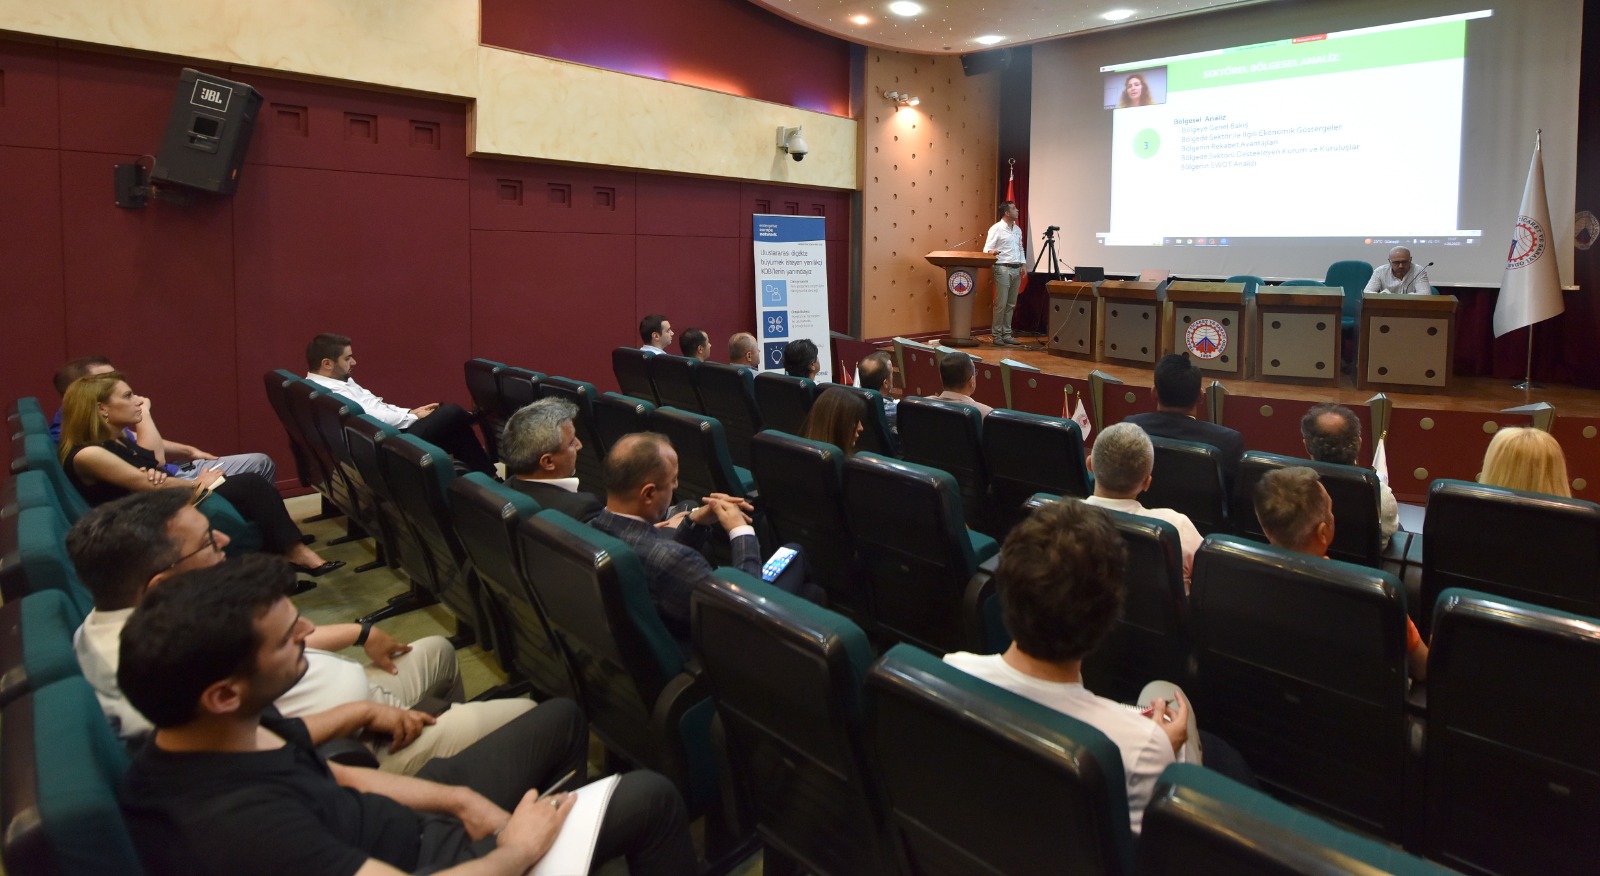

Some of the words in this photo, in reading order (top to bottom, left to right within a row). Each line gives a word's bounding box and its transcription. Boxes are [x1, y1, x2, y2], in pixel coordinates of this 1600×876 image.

[1202, 64, 1249, 79] SEKTÖREL
[1250, 58, 1299, 72] BÖLGESEL
[1300, 51, 1340, 66] ANALİZ
[200, 88, 222, 104] JBL
[1174, 116, 1202, 126] Bölgesel
[1204, 114, 1227, 122] Analiz
[1209, 122, 1229, 131] Genel
[1181, 134, 1208, 143] Bölgede
[1258, 128, 1295, 137] Ekonomik
[1296, 123, 1343, 134] Göstergeler
[1143, 141, 1150, 150] 3
[1181, 143, 1210, 153] Bölgenin
[1211, 141, 1240, 150] Rekabet
[1181, 152, 1208, 162] Bölgede
[1236, 148, 1281, 158] Destekleyen
[1282, 146, 1308, 154] Kurum
[1319, 143, 1360, 153] Kuruluşlar
[1210, 160, 1232, 169] SWOT
[760, 258, 784, 267] büyümek
